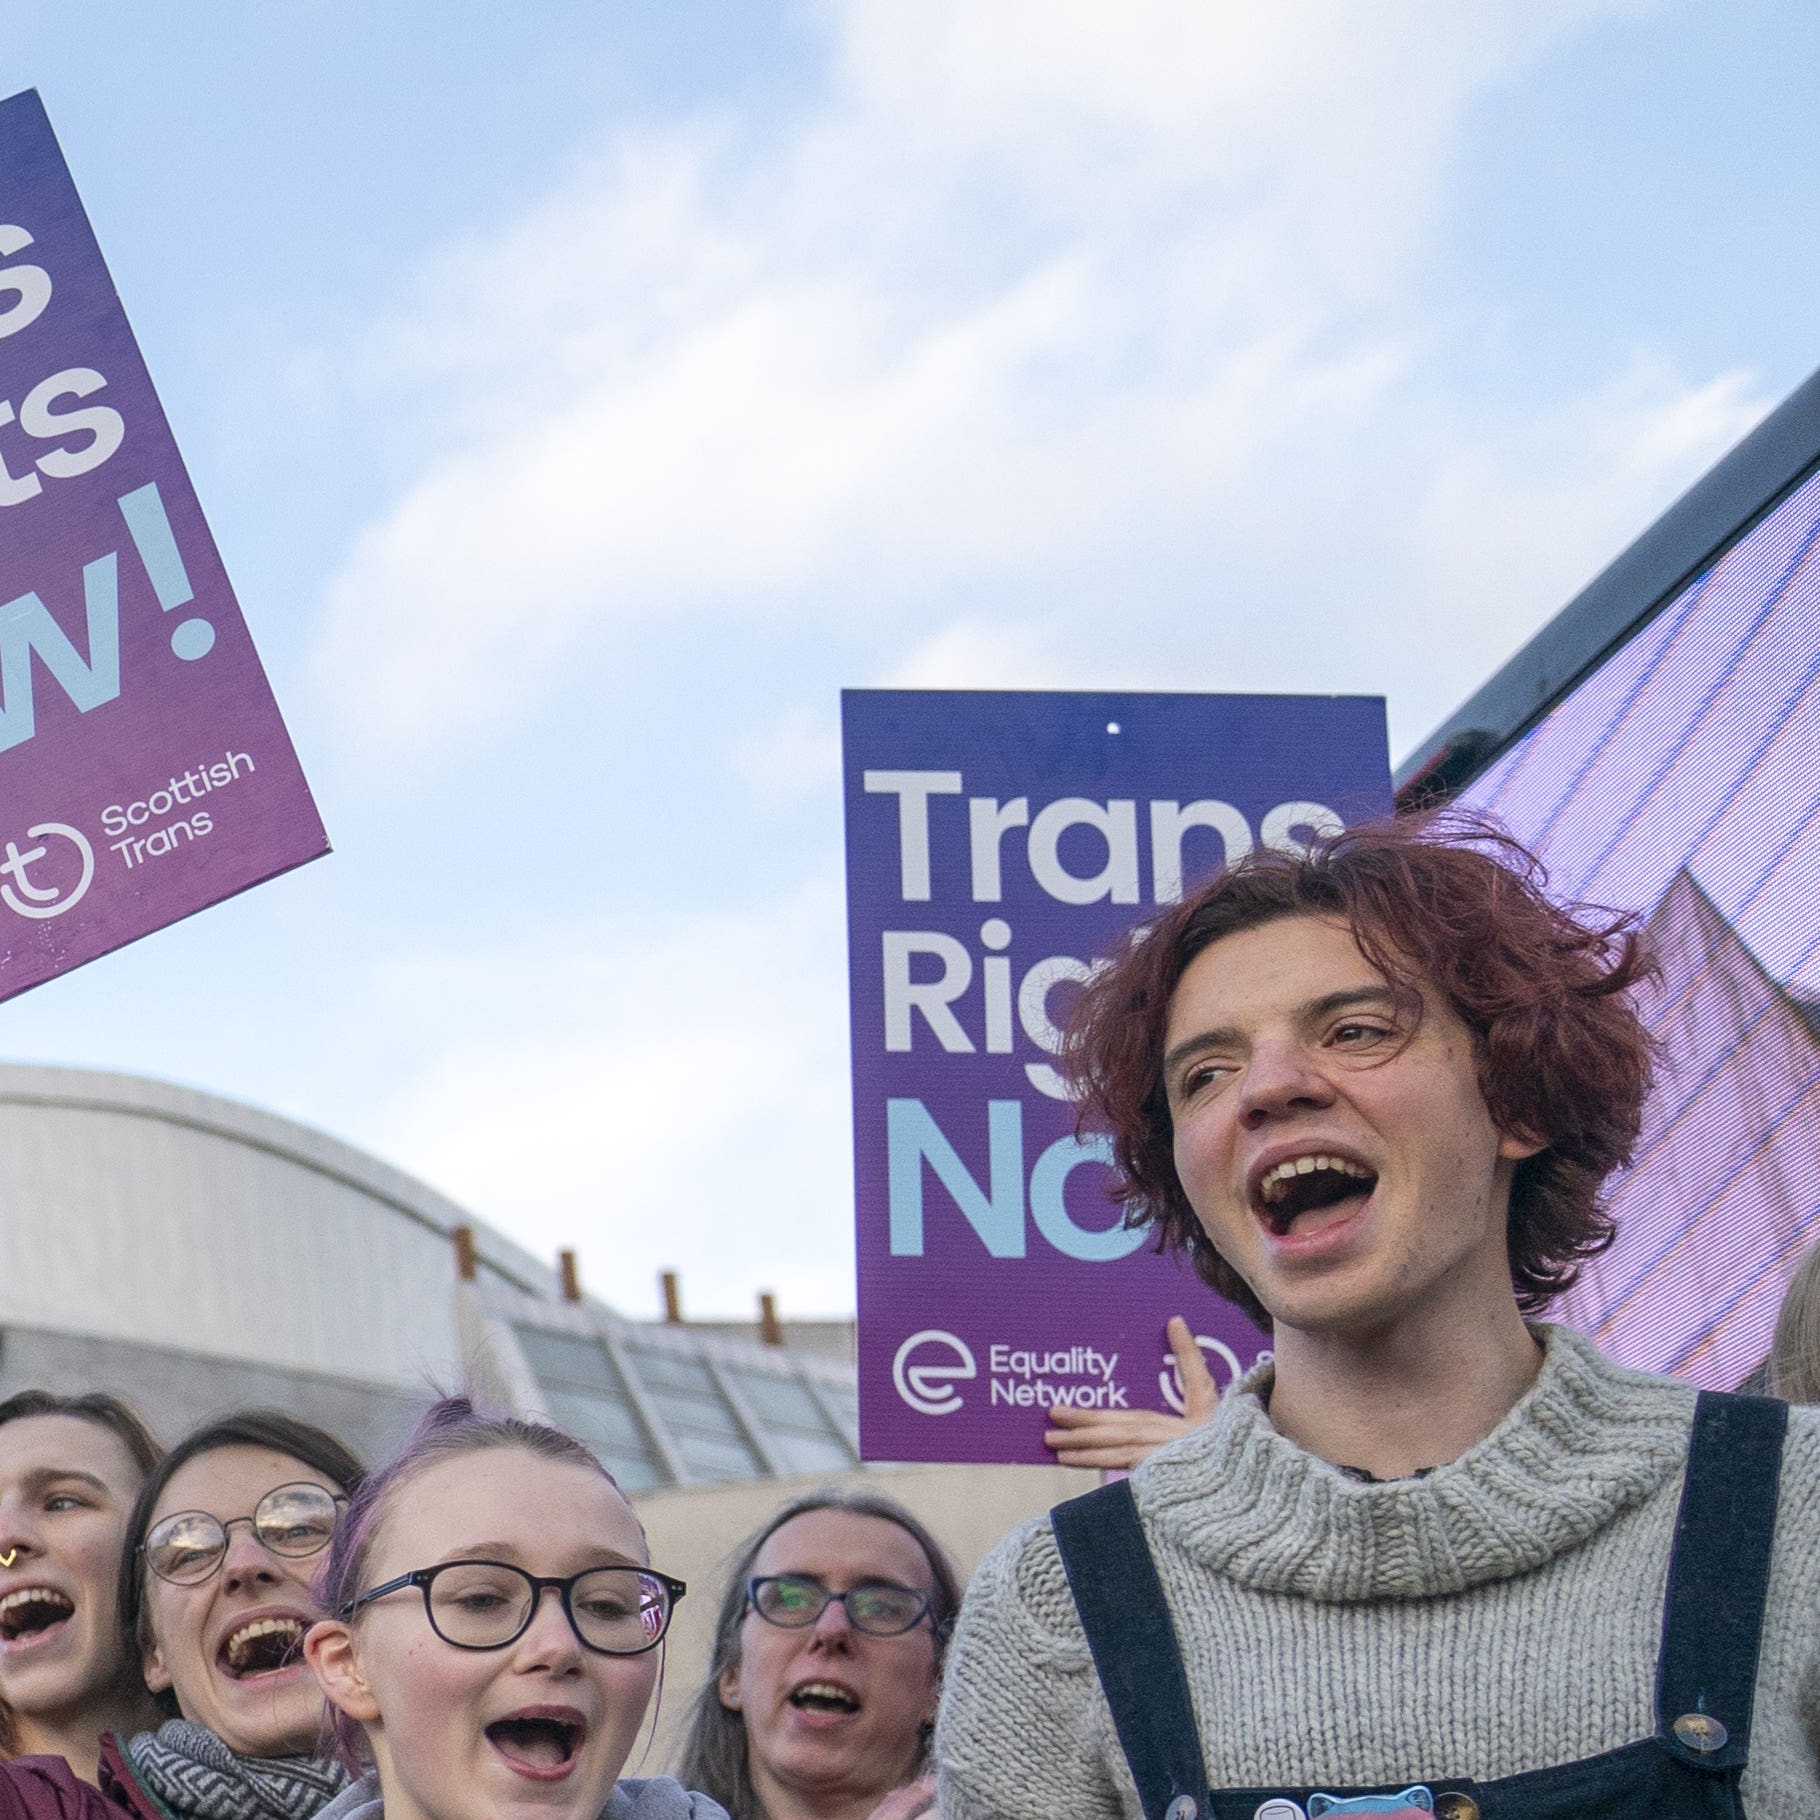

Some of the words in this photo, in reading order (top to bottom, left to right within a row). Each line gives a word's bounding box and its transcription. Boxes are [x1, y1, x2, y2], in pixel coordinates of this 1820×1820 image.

[100, 749, 255, 838] Scottish
[111, 806, 214, 872] Trans
[882, 919, 1118, 1101] Rig
[886, 1098, 1156, 1262] No
[990, 1345, 1118, 1380] Equality
[990, 1379, 1128, 1409] Network
